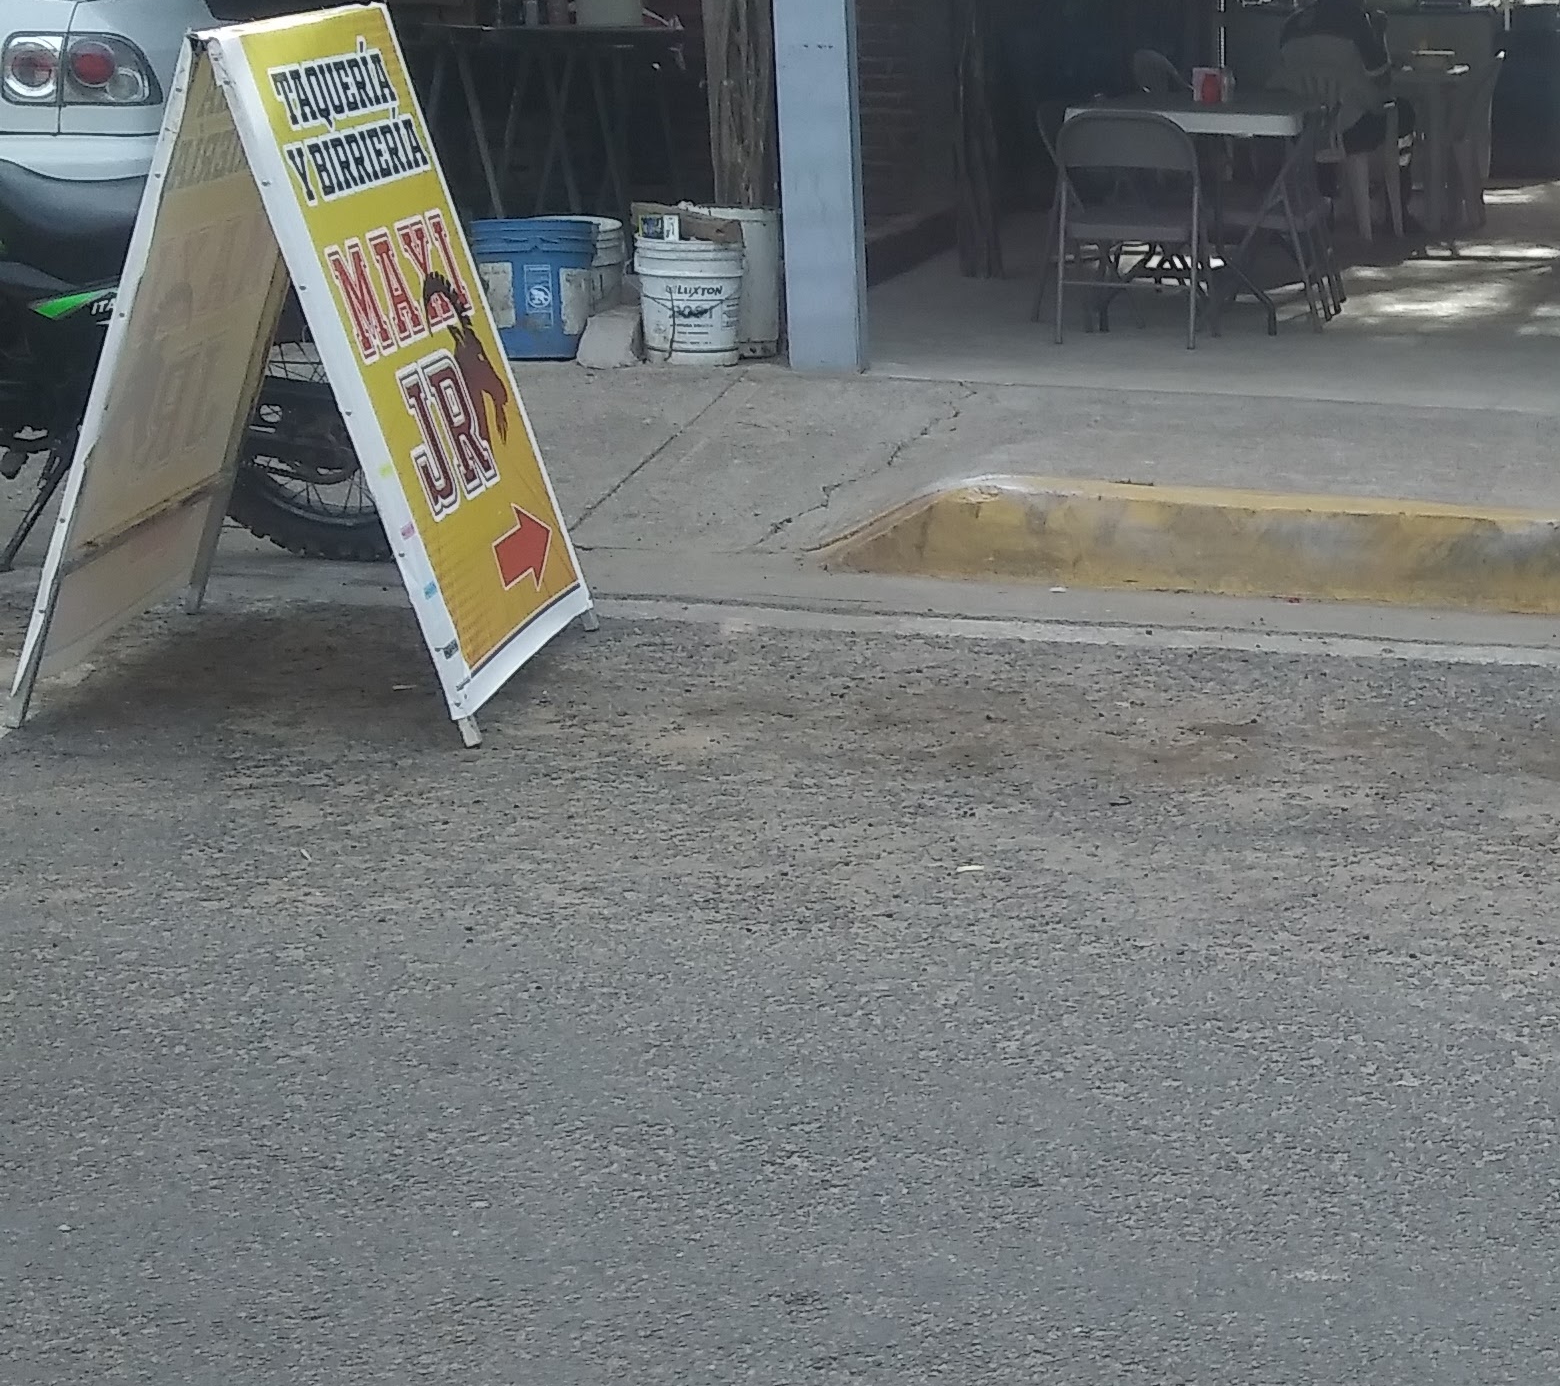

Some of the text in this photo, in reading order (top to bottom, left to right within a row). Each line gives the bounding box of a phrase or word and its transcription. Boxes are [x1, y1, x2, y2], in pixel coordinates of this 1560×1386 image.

[270, 39, 397, 130] TAQUERÍA
[285, 146, 317, 203] Y
[306, 106, 430, 197] BIRRIERÍA
[326, 210, 475, 365] MAXI
[395, 350, 501, 523] JR
